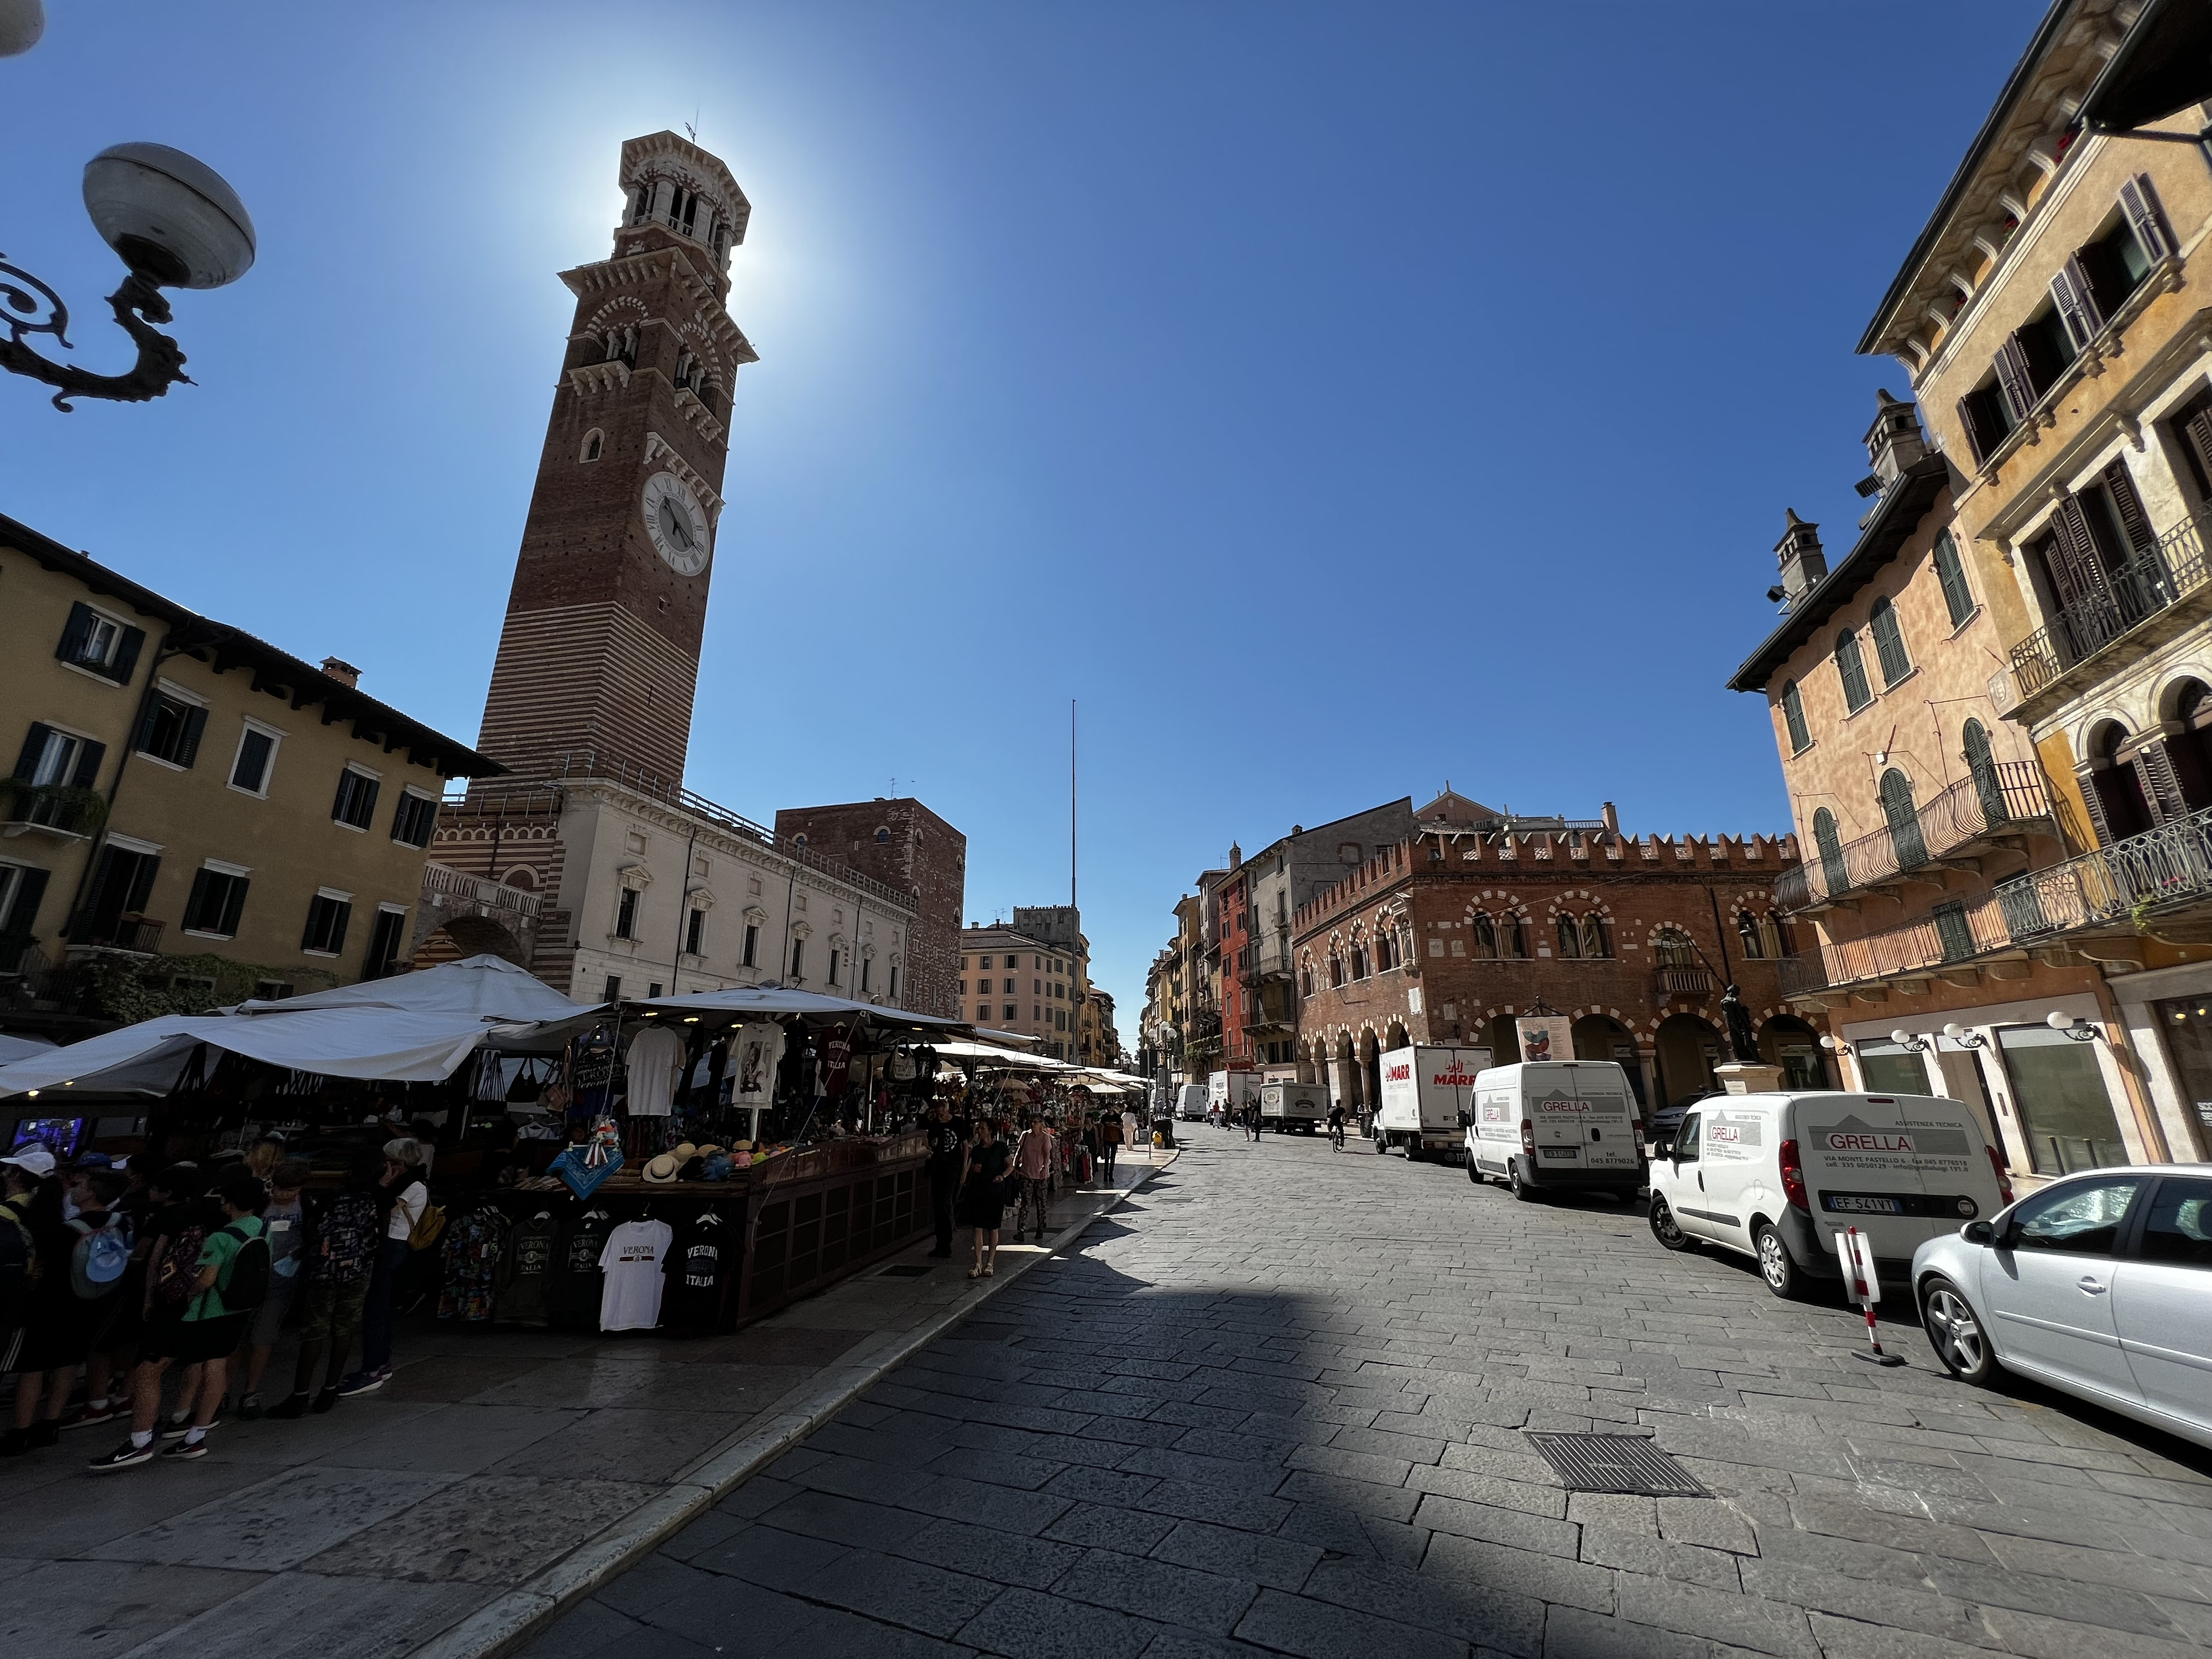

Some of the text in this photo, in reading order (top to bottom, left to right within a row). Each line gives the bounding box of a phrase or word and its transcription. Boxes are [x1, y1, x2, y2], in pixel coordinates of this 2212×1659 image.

[1391, 1064, 1410, 1082] MARR
[1544, 1102, 1590, 1112] GRELLA
[1712, 1127, 1738, 1141] GRELLA
[1830, 1134, 1912, 1151] GRELLA
[1835, 1198, 1892, 1211] EF 541VT
[520, 1240, 549, 1250] VERONA
[573, 1239, 597, 1248] VERONA
[624, 1245, 654, 1254] VERONA
[687, 1245, 718, 1260] VERONA
[686, 1274, 713, 1287] ITALIA
